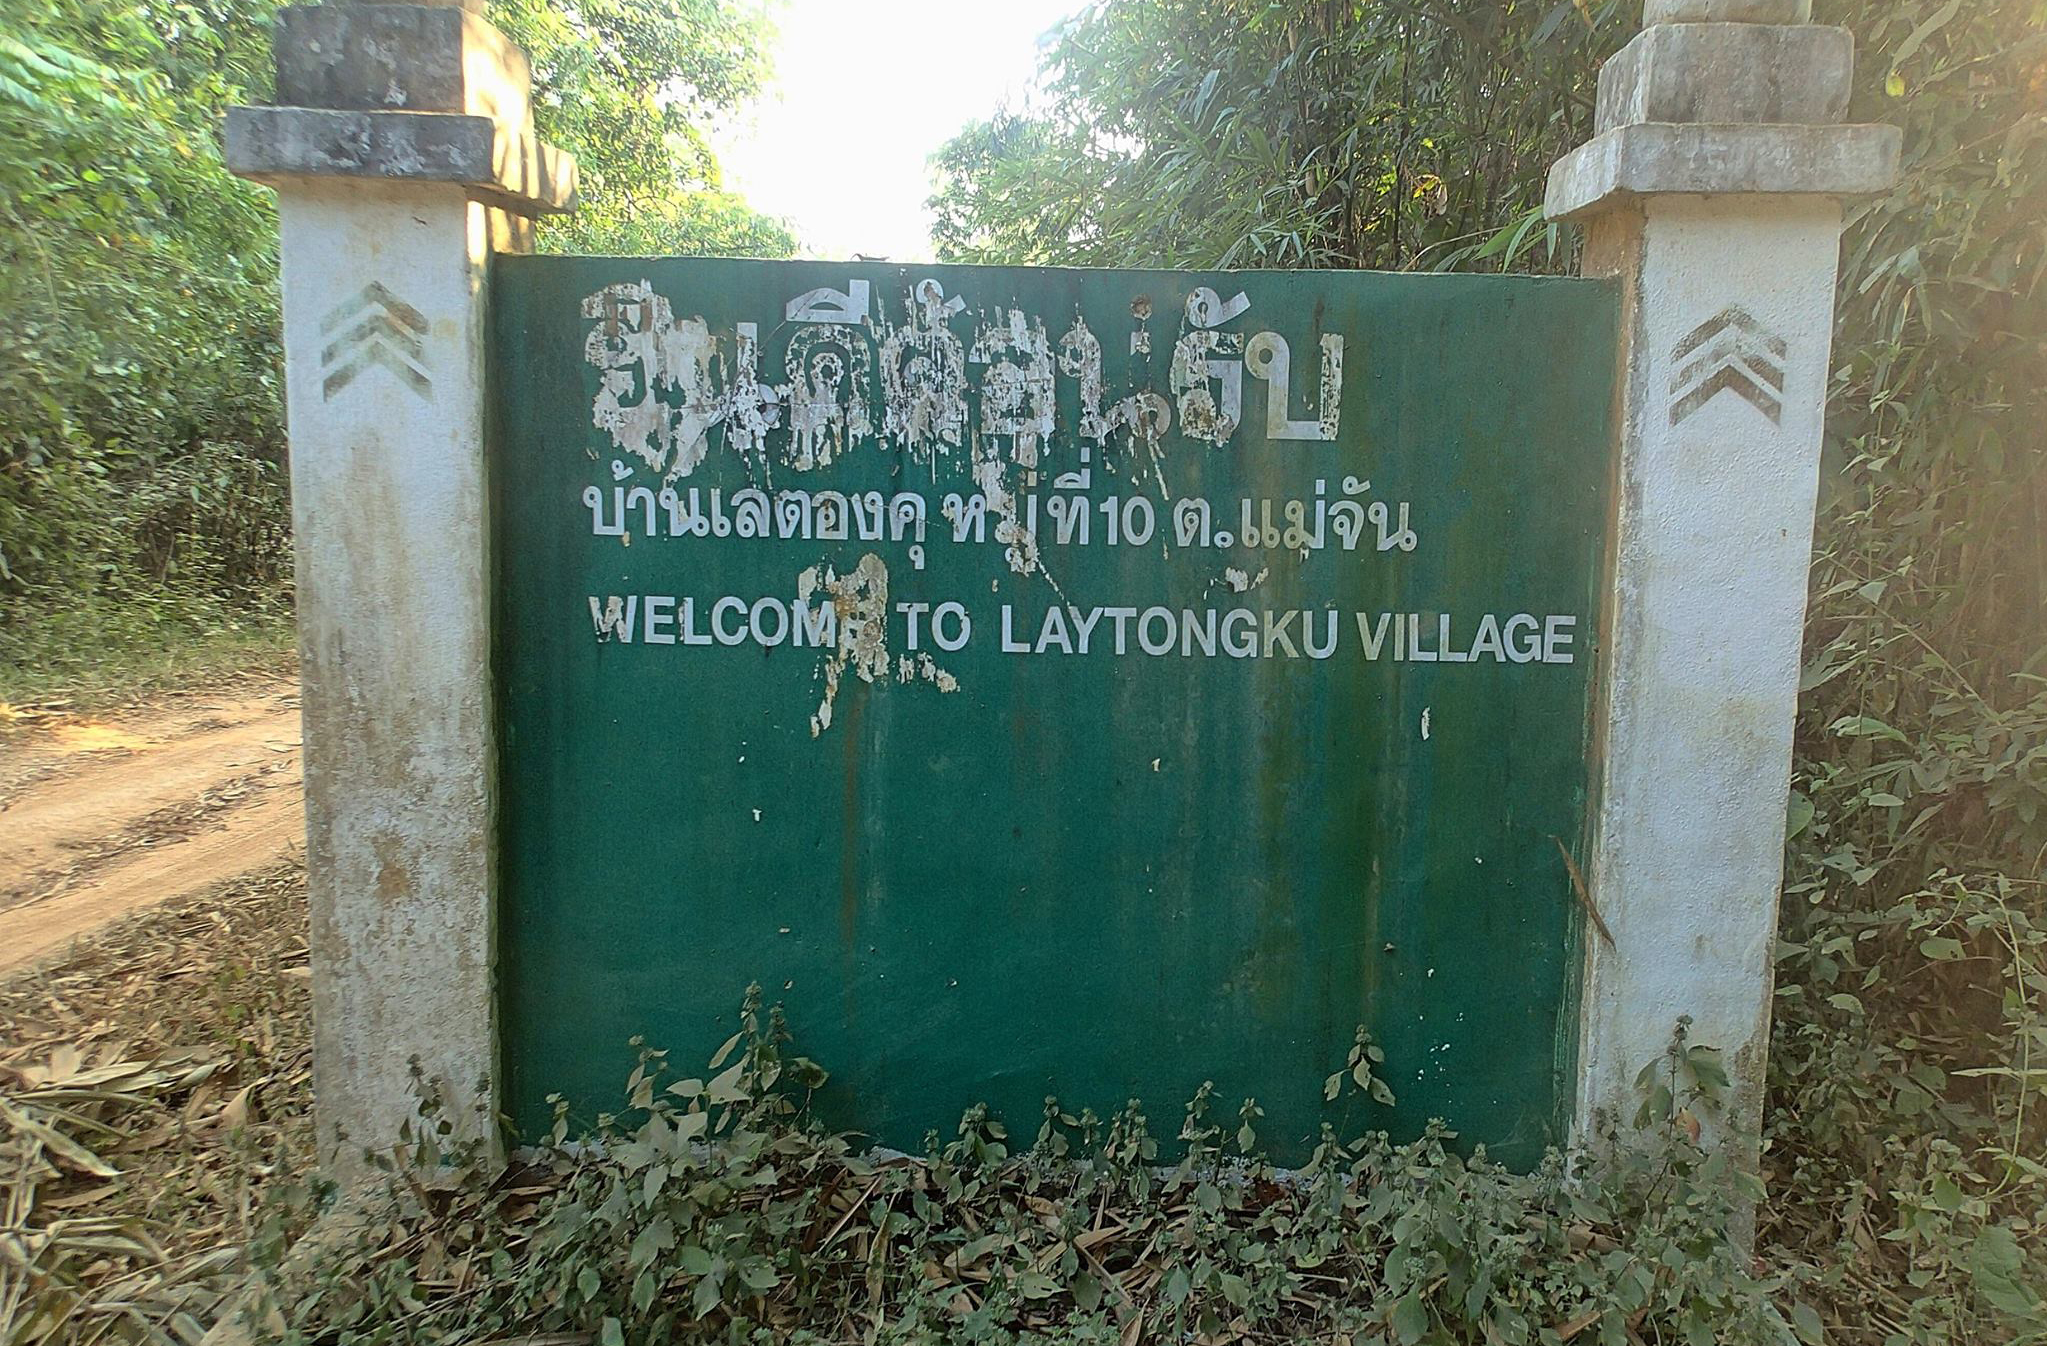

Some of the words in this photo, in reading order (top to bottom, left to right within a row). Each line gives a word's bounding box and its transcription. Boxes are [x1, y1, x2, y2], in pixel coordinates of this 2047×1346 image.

[582, 459, 926, 570] บ้านเลตองคุ
[896, 602, 972, 652] TO
[1001, 605, 1339, 659] LAYTONGKU
[1356, 611, 1577, 664] VILLAGE
